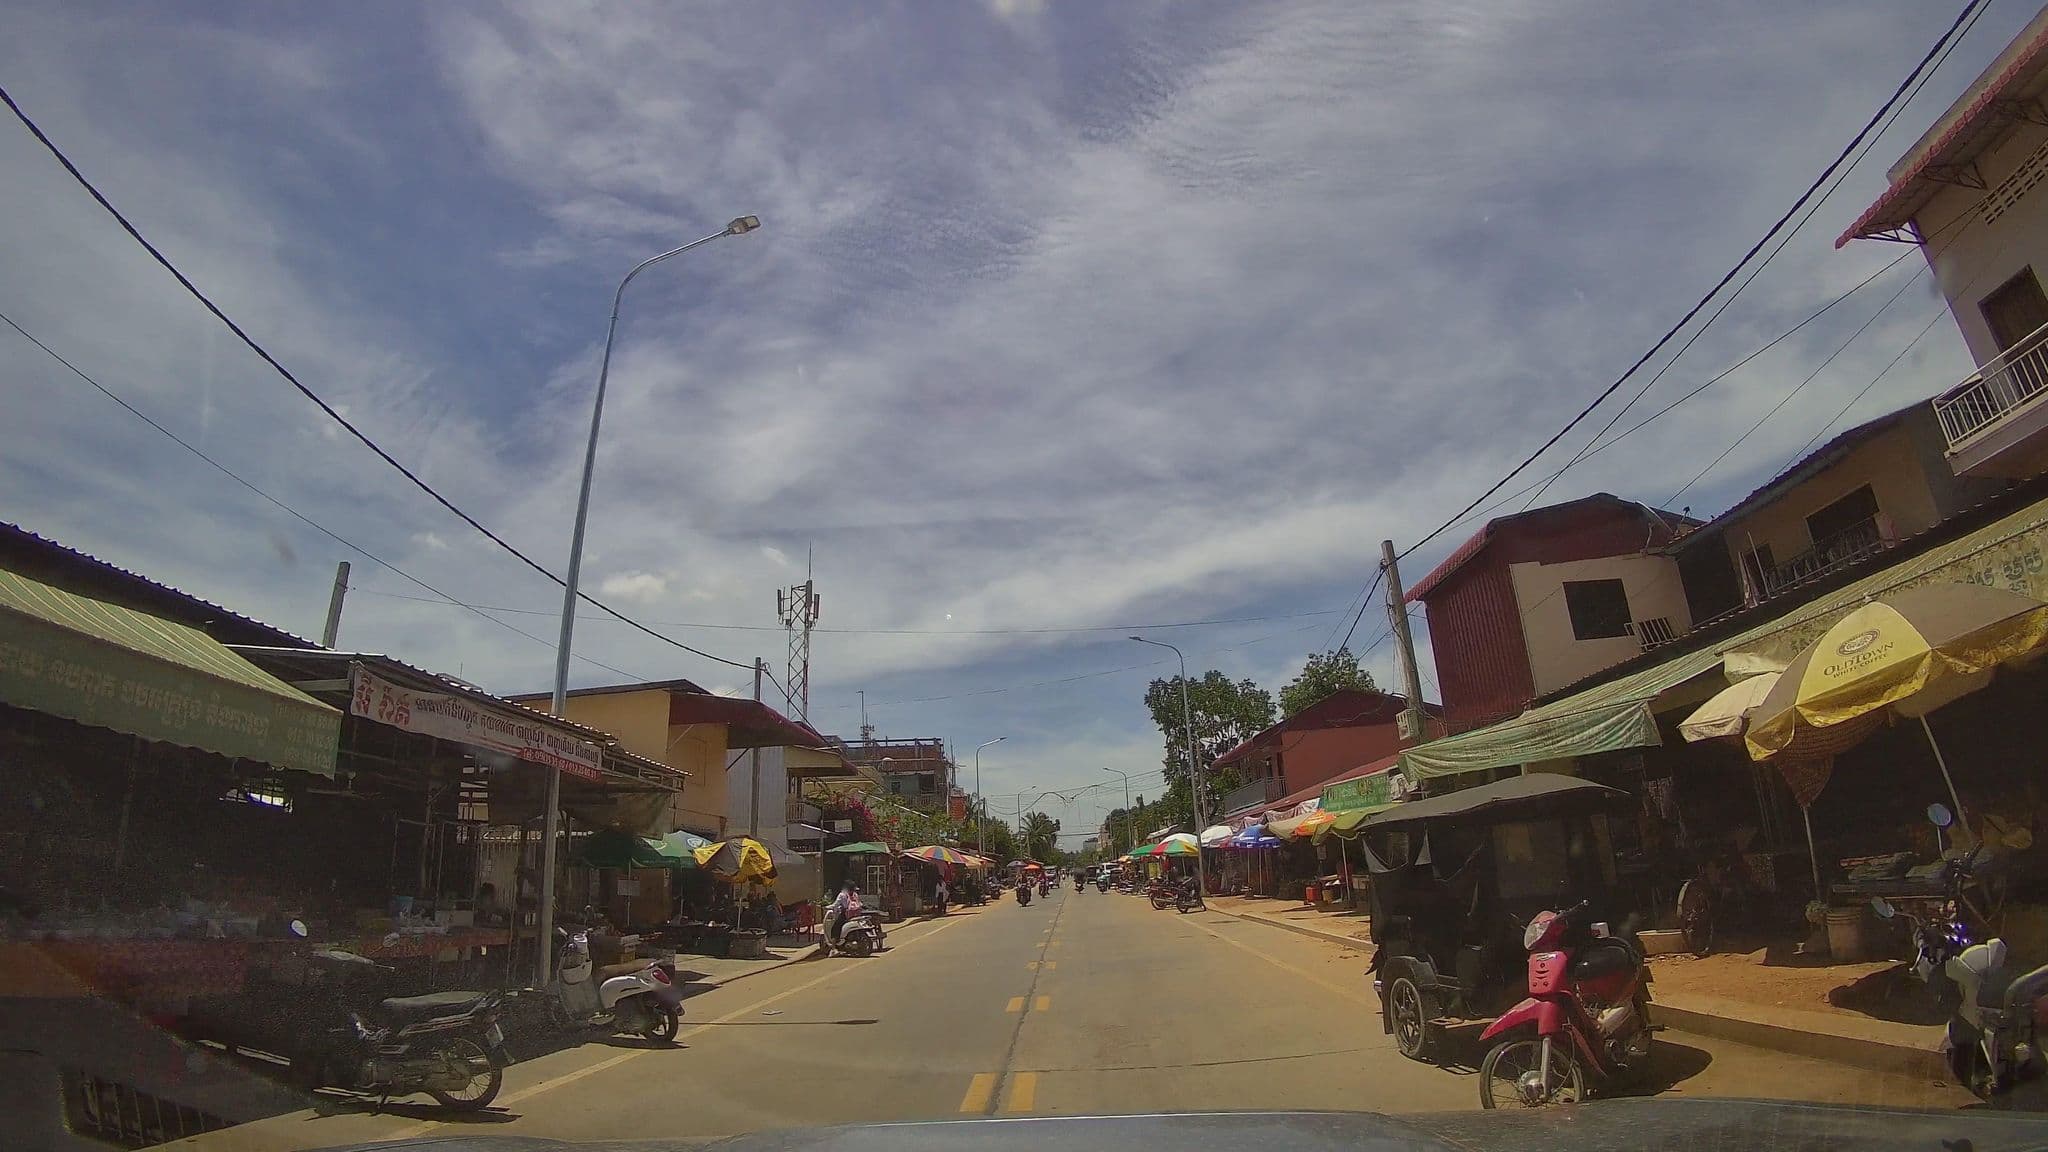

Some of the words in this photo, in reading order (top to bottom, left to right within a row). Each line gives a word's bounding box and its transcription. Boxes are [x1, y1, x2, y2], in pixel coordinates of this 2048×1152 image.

[1823, 641, 1895, 676] OLDTOWN
[1833, 664, 1857, 678] WHITE
[1859, 653, 1888, 667] COFFEE
